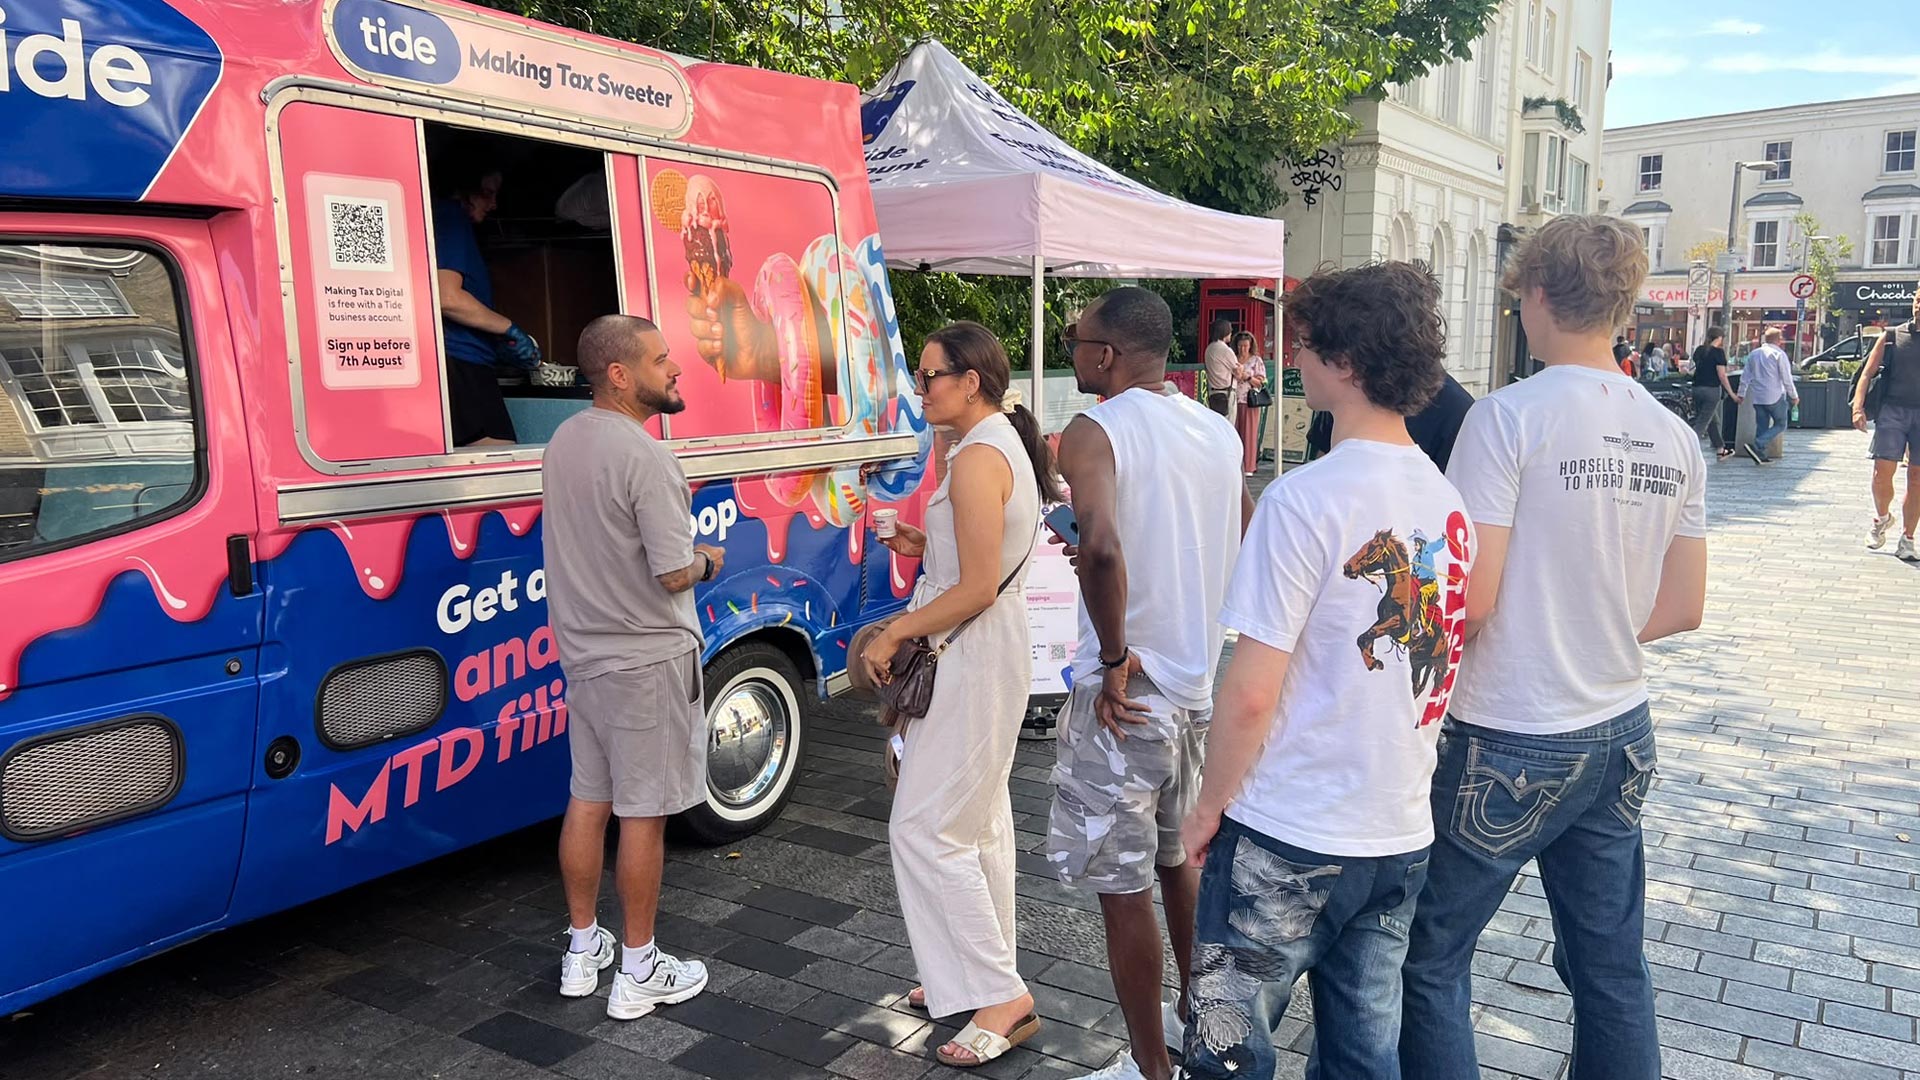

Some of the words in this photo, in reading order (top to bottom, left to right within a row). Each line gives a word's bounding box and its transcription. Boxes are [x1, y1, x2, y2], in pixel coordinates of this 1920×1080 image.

[359, 16, 437, 65] tide
[469, 43, 551, 89] Making
[556, 63, 594, 92] Tax
[597, 72, 672, 108] Sweeter
[864, 146, 908, 161] ide
[324, 286, 357, 297] Making
[359, 287, 374, 296] Tax
[376, 288, 403, 298] Digital
[328, 299, 336, 308] is
[337, 299, 355, 308] free
[357, 300, 376, 309] with
[384, 300, 402, 309] Tide
[329, 312, 366, 321] business
[368, 313, 403, 322] account.
[327, 339, 353, 353] Sign
[356, 341, 371, 352] up
[373, 339, 410, 350] before
[338, 355, 359, 366] 7th
[362, 355, 402, 368] August
[1564, 475, 1580, 490] TO
[1586, 473, 1623, 489] HYBRD
[1629, 477, 1642, 492] IN
[1643, 480, 1677, 498] POWER
[436, 569, 519, 634] Get
[325, 727, 485, 846] MTD
[664, 974, 676, 987] N
